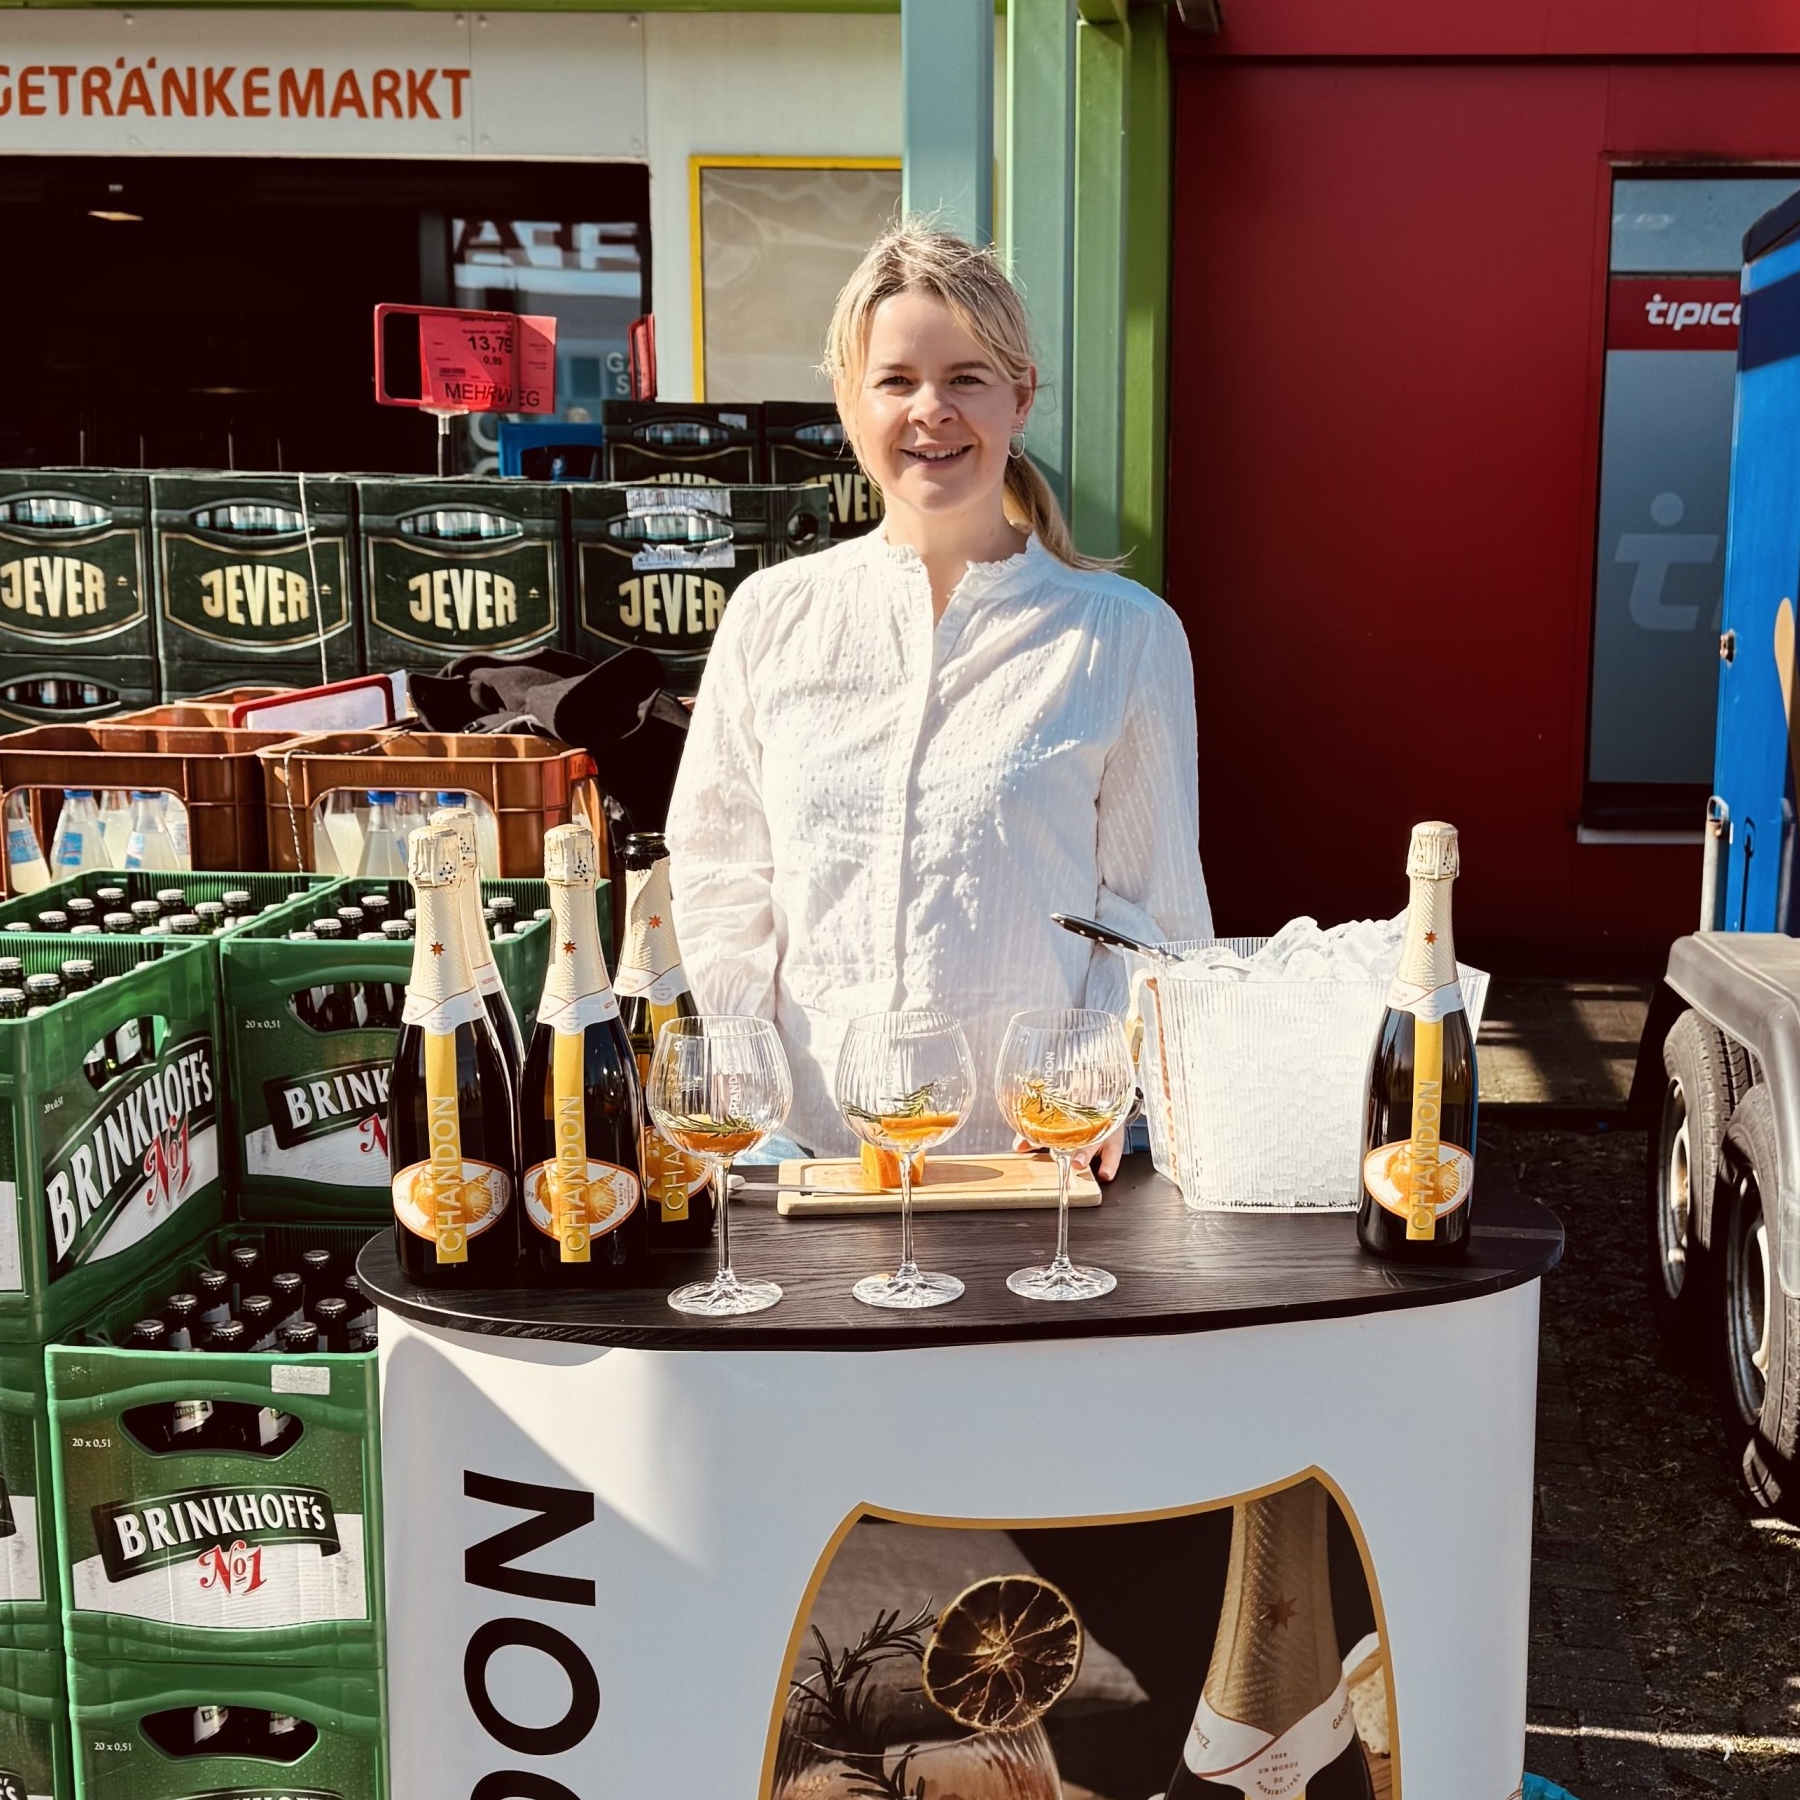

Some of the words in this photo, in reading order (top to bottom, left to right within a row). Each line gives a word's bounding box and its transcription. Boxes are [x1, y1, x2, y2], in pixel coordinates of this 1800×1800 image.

[444, 381, 541, 408] MEHRWEG
[0, 556, 107, 618] JEVER
[200, 565, 310, 627] JEVER
[408, 568, 518, 631] JEVER
[618, 573, 727, 635] JEVER
[283, 1068, 390, 1130] BRINK
[431, 1096, 464, 1253] CHANDON
[559, 1096, 587, 1252] CHANDON
[1411, 1080, 1440, 1231] CHANDON
[72, 1437, 85, 1448] 20
[463, 1469, 600, 1800] ON
[94, 1742, 106, 1751] 20
